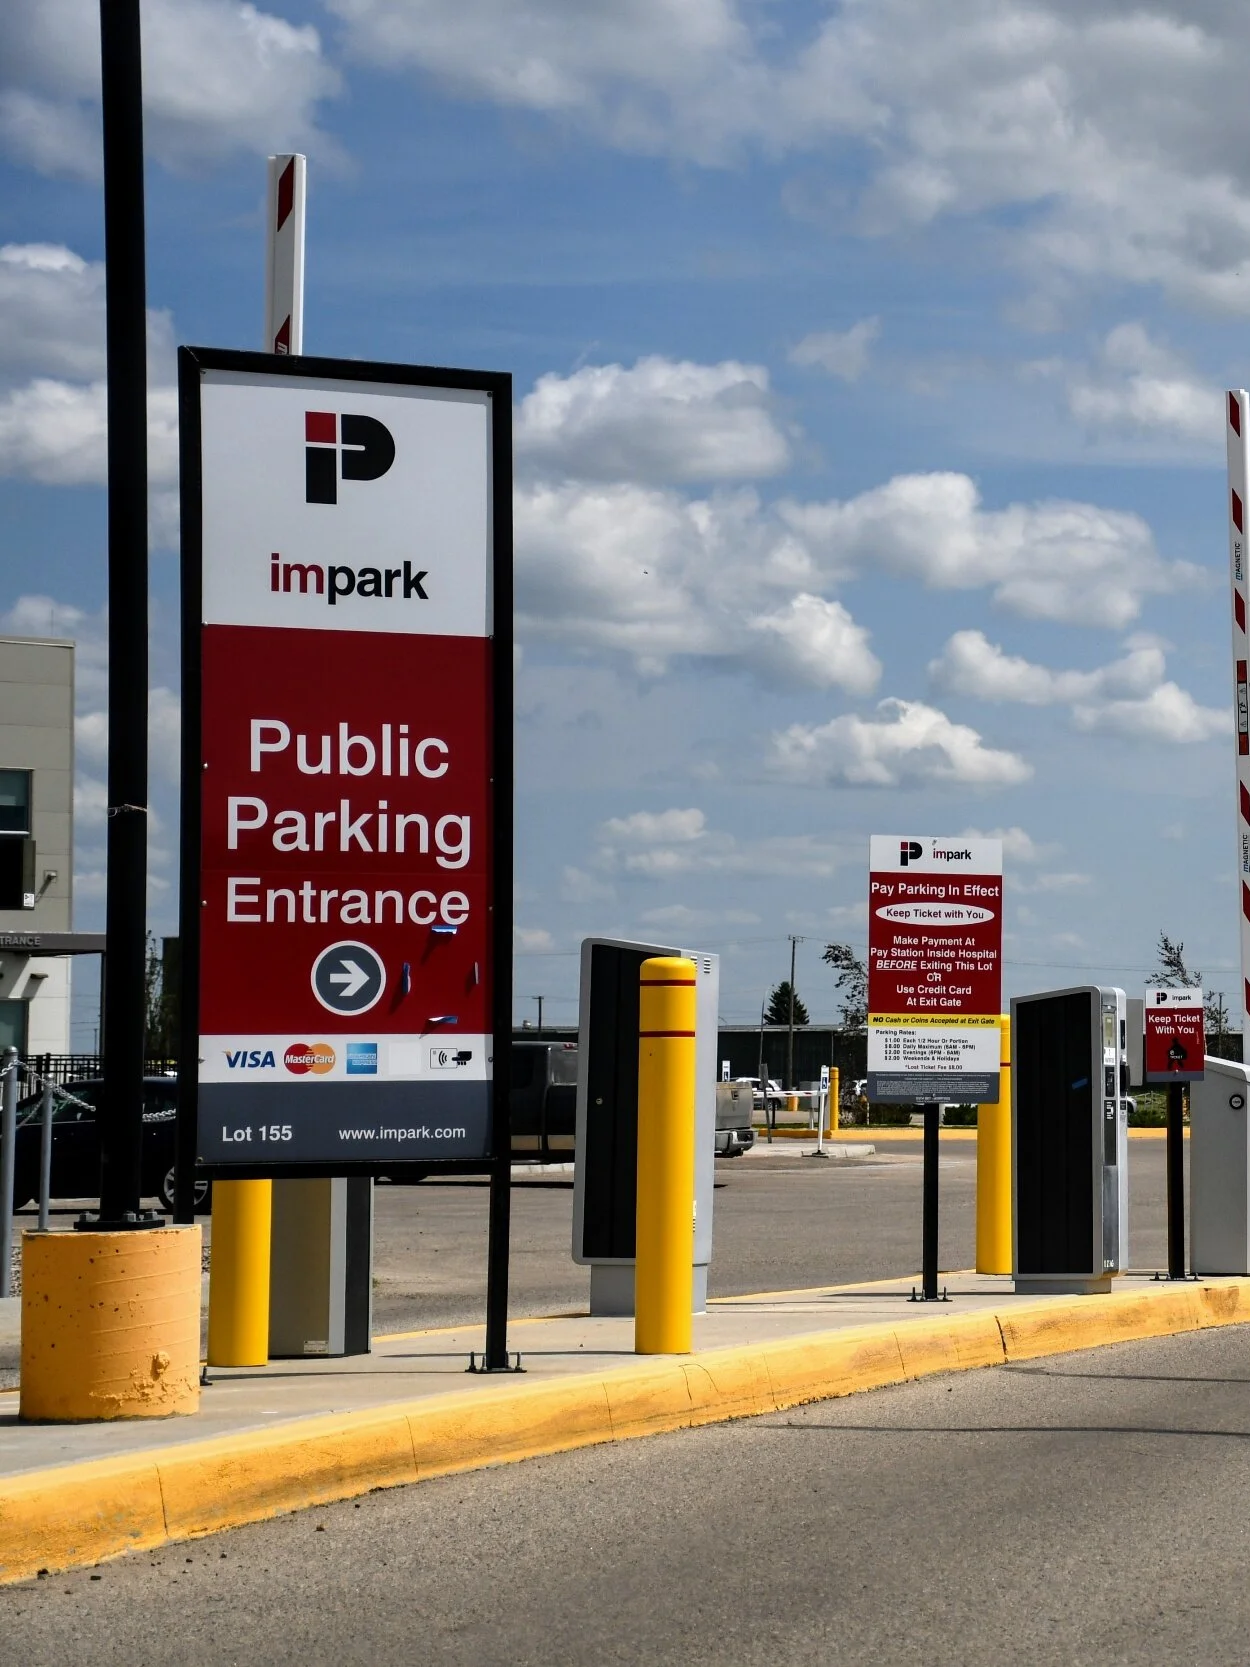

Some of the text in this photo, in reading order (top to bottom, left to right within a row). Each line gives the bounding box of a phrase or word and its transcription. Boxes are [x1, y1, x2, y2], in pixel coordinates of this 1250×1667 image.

[271, 553, 429, 605] impark
[250, 719, 449, 778] Public
[227, 796, 471, 869] Parking
[932, 848, 972, 862] impark
[871, 882, 999, 898] Pay Parking In Effect
[227, 877, 470, 925] Entrance
[886, 909, 984, 919] Keep Ticket with You
[893, 936, 975, 947] Make Payment At
[870, 947, 997, 960] Pay Station Inside Hospital
[876, 960, 993, 972] BEFORE Exiting This Lot
[926, 972, 942, 982] OR
[896, 984, 972, 995] Use Credit Card
[906, 996, 962, 1007] At Exit Gate
[1172, 994, 1192, 1002] impark
[1148, 1014, 1200, 1024] Keep Ticket
[1155, 1026, 1195, 1034] With You
[222, 1050, 276, 1068] VISA
[284, 1053, 335, 1065] MasterCard
[222, 1125, 293, 1142] Lot 155
[338, 1126, 466, 1142] www.impark.com
